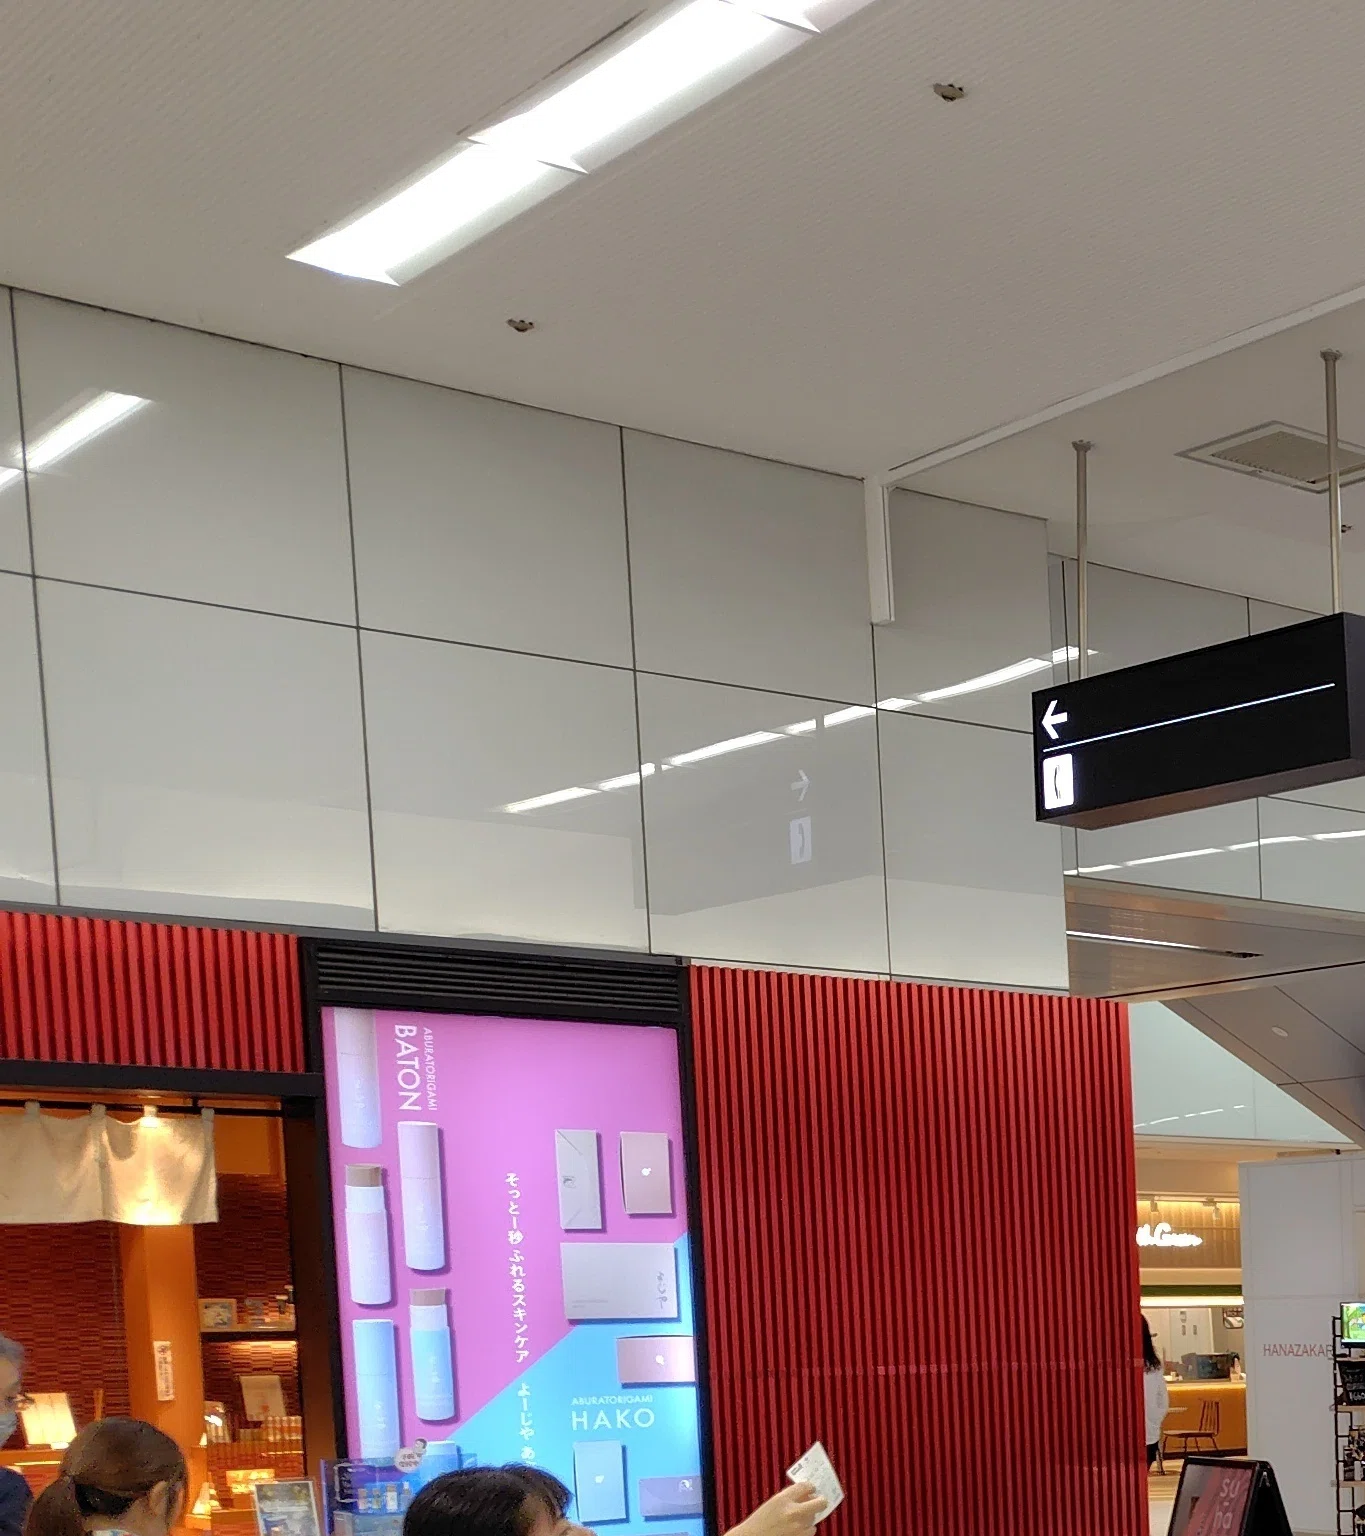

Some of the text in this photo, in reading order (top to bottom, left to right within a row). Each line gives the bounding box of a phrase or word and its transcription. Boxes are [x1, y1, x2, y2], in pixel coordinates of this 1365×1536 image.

[394, 1024, 422, 1111] BATON
[423, 1027, 438, 1110] ABURATORIGAMI
[509, 1249, 530, 1363] ふれるスキンケア
[517, 1382, 535, 1441] よーじや
[570, 1408, 655, 1431] HAKO
[571, 1394, 653, 1406] ABURATORIGAMI
